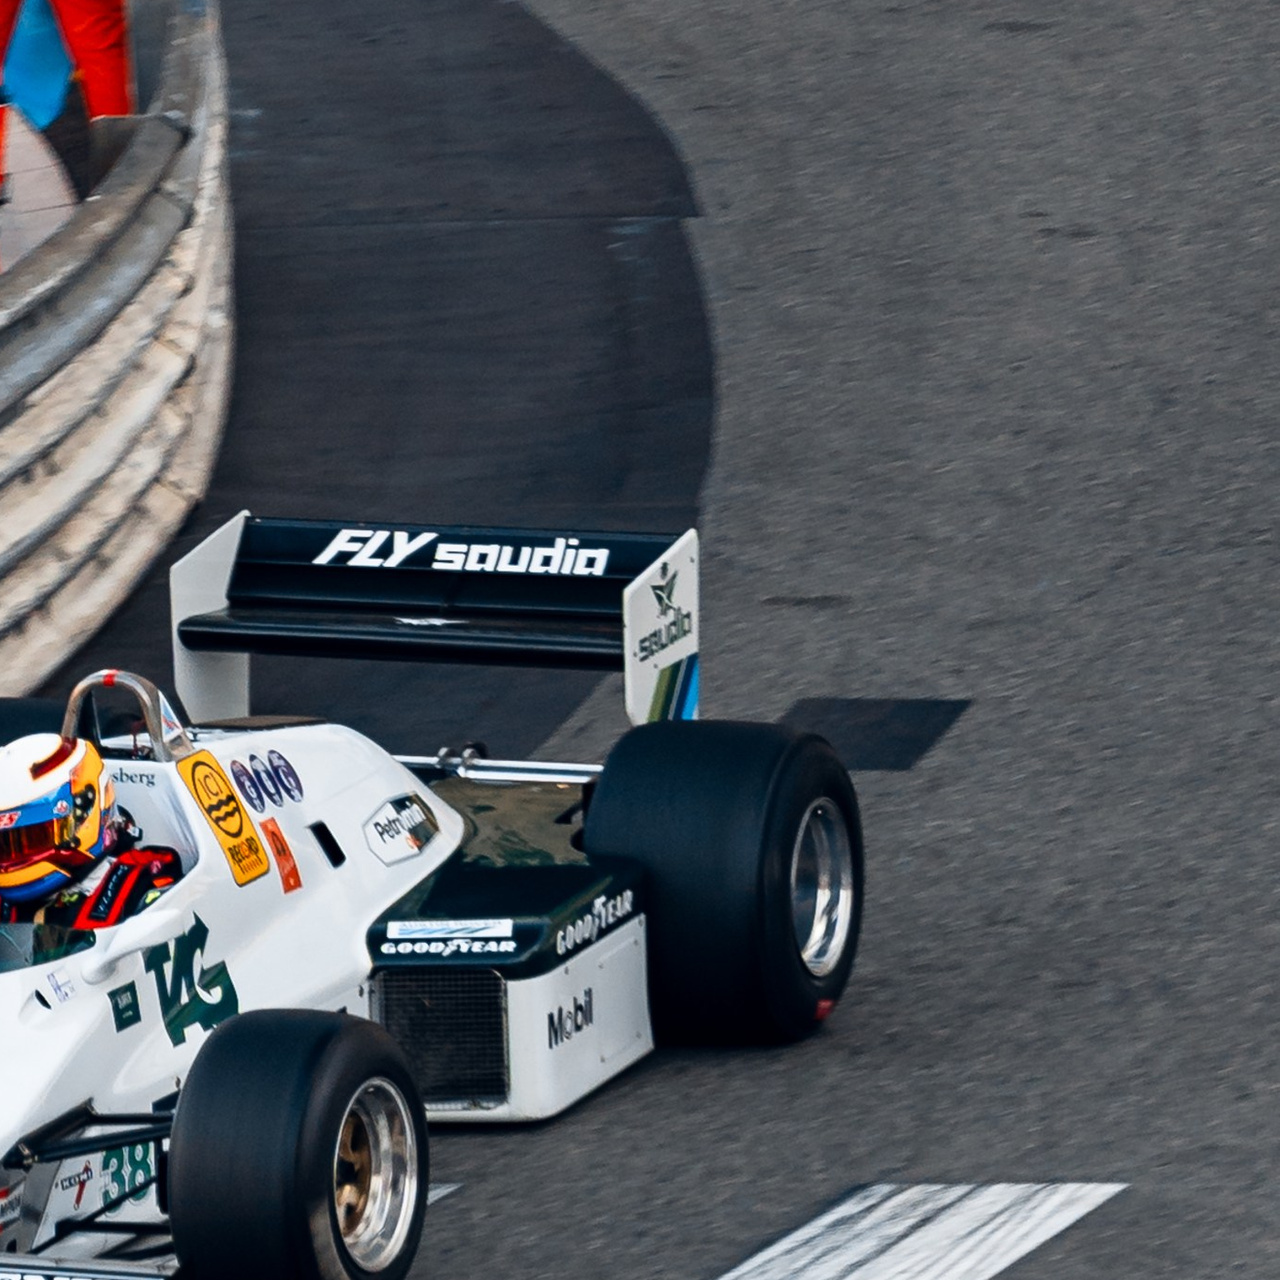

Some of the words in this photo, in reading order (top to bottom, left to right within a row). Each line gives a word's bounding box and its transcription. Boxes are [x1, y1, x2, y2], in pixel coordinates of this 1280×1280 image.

[312, 529, 438, 567] FLY
[432, 538, 609, 576] saudia
[111, 768, 156, 787] sberg
[198, 772, 224, 801] ICI
[142, 911, 240, 1048] TAG
[547, 987, 594, 1049] Mobil
[101, 1142, 153, 1214] 38
